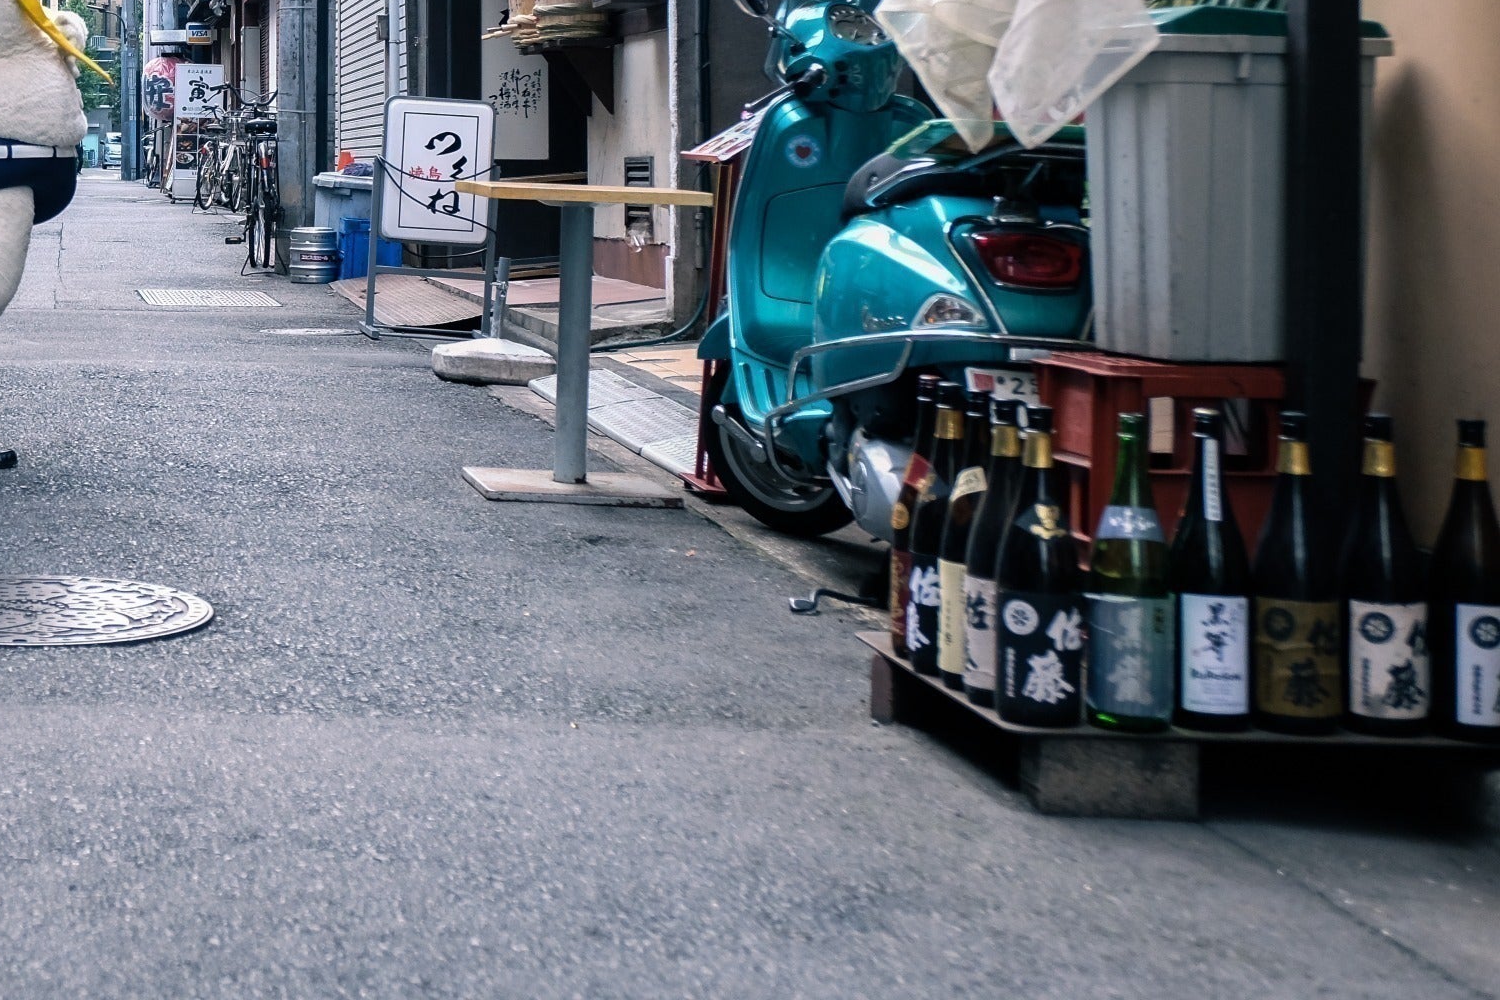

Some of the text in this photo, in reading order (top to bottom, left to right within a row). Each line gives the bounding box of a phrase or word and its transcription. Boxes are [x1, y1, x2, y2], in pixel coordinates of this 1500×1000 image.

[409, 166, 442, 180] 焼鳥
[424, 131, 467, 214] つくね
